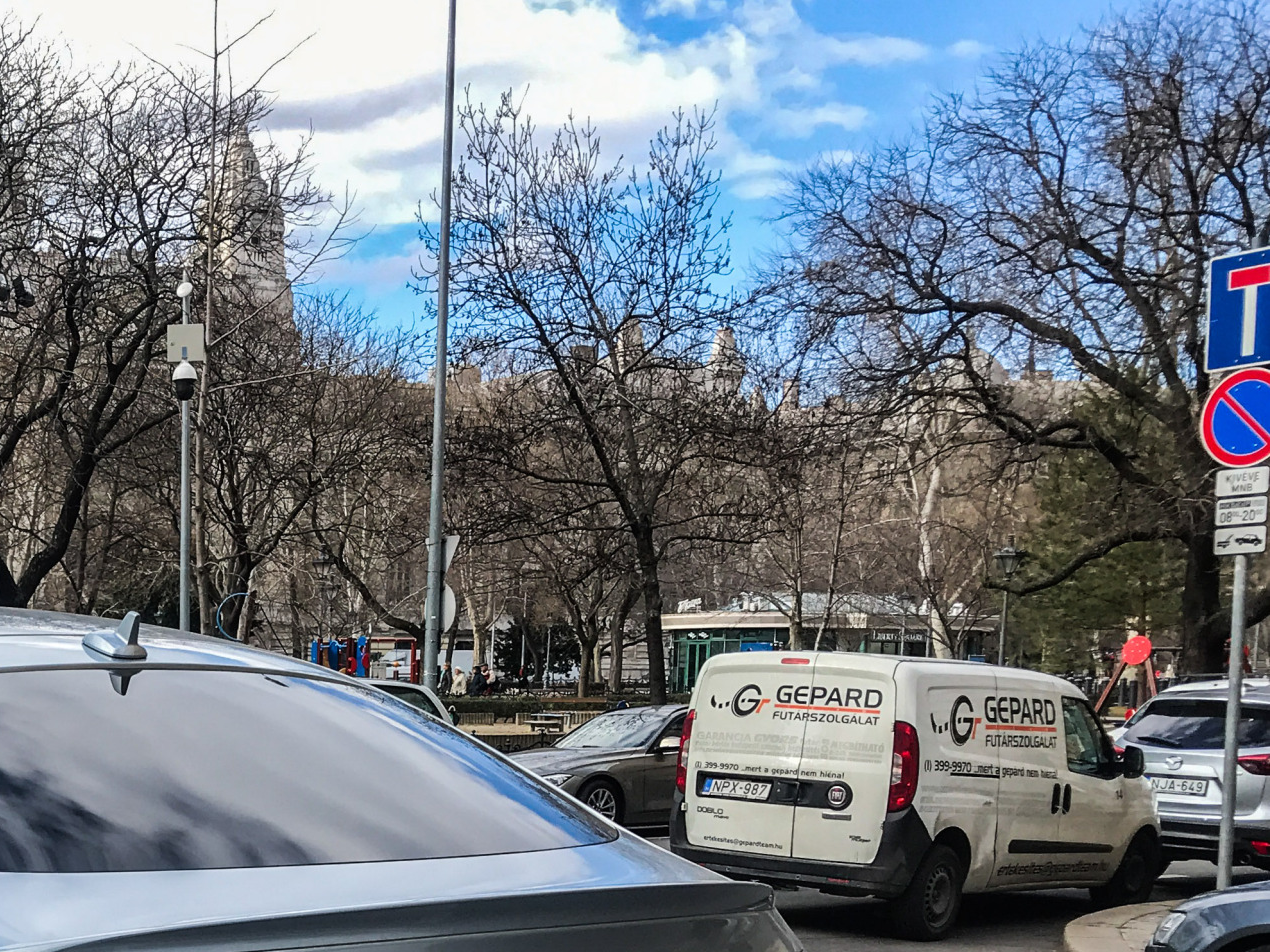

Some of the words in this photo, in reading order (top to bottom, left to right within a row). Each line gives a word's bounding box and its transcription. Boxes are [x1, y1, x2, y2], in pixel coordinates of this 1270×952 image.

[1232, 483, 1252, 492] MNB
[776, 685, 883, 709] GEPARD
[984, 696, 1056, 725] GEPARD
[772, 710, 880, 726] FUTÁRSZOLGÁLAT
[704, 761, 739, 771] 399-9970
[934, 760, 972, 773] 399-9970
[712, 780, 767, 795] NPX-987
[1152, 779, 1203, 793] NJA-649
